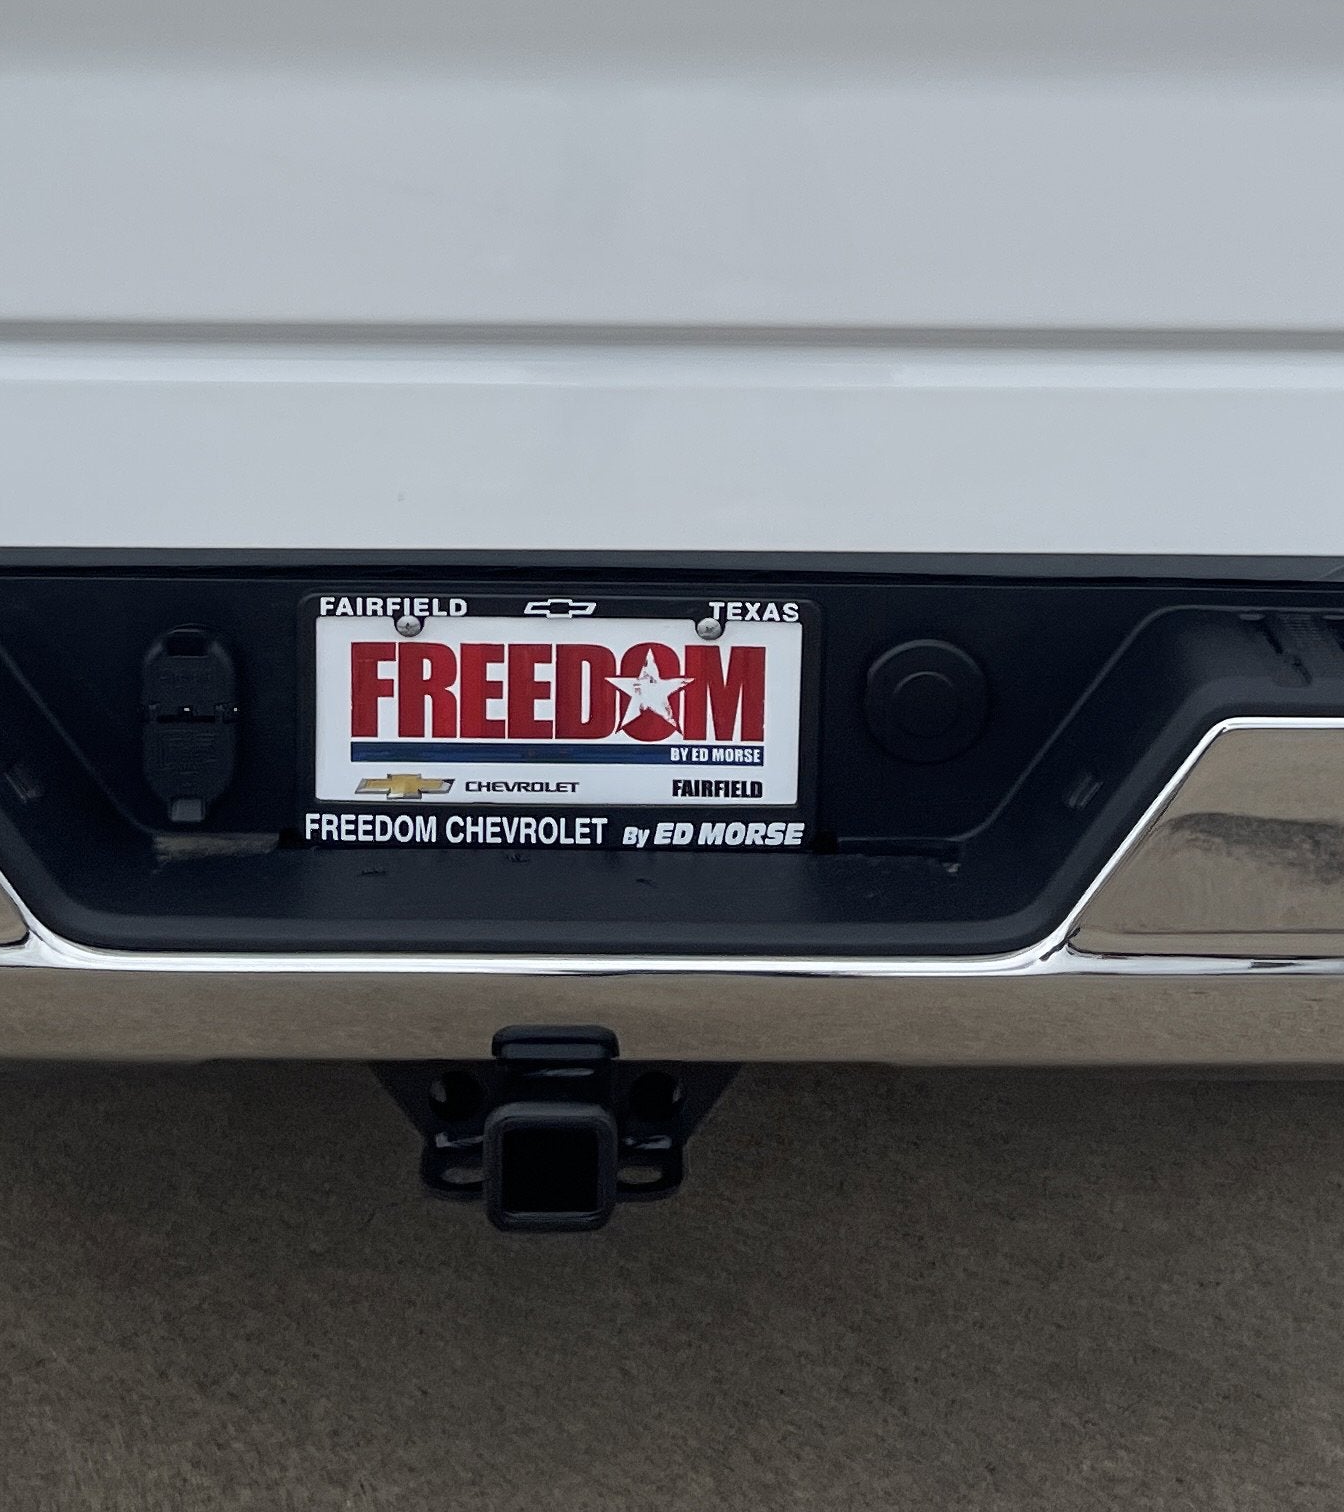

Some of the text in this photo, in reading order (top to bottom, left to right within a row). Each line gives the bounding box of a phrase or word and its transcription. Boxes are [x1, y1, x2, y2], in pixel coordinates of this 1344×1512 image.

[319, 596, 468, 617] FAIRFIELD
[709, 601, 800, 623] TEXAS
[350, 641, 767, 743] FREEDOM
[670, 747, 761, 763] BY ED MORSE
[465, 780, 580, 794] CHEVROLET
[672, 779, 763, 798] FAIRFIELD
[305, 813, 805, 848] FREEDOM CHEVROLET By ED MORSE
